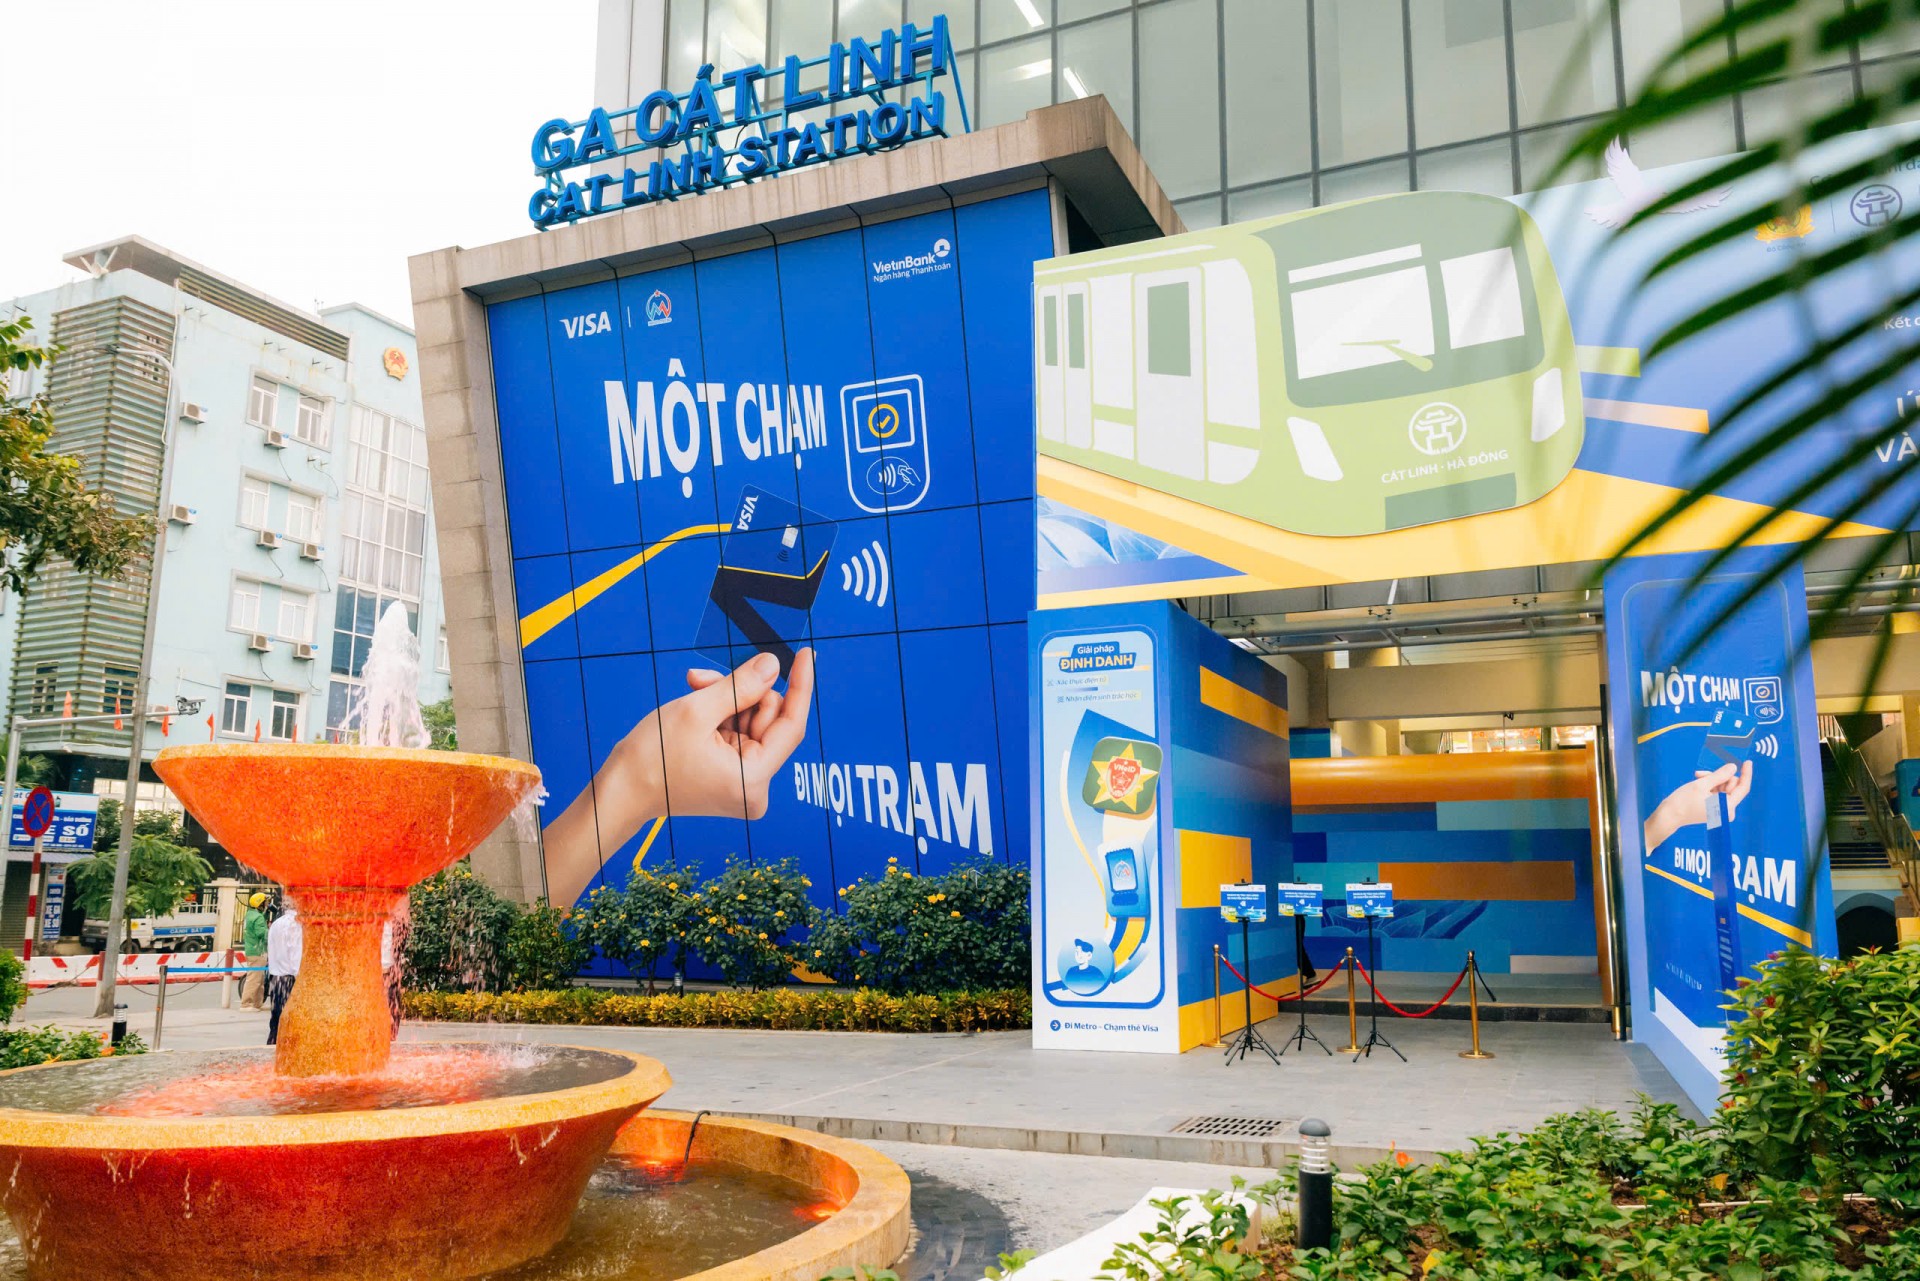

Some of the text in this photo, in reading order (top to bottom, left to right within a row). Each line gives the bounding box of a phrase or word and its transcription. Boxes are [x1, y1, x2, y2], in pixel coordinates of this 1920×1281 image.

[531, 14, 947, 170] GA CÁT LINH
[528, 91, 944, 223] CAT LINH STATION
[873, 252, 936, 274] VietinBank
[873, 262, 951, 283] Ngân hàng Thanh toán
[560, 311, 611, 339] VISA
[604, 358, 827, 499] MỘT CHẠM
[1875, 432, 1919, 463] VÀ
[1381, 450, 1508, 483] CÁT LINH HÀ ĐÔNG
[736, 494, 759, 531] VISA
[1061, 654, 1132, 671] ĐỊNH DANH
[1078, 645, 1114, 654] Giải pháp
[1640, 666, 1740, 713] MỘT CHẠM
[794, 761, 994, 856] ĐI MỌI TRẠM
[62, 823, 90, 837] SỐ
[1674, 847, 1796, 908] ĐI MỌI RẠM
[1104, 1023, 1126, 1032] Chạm
